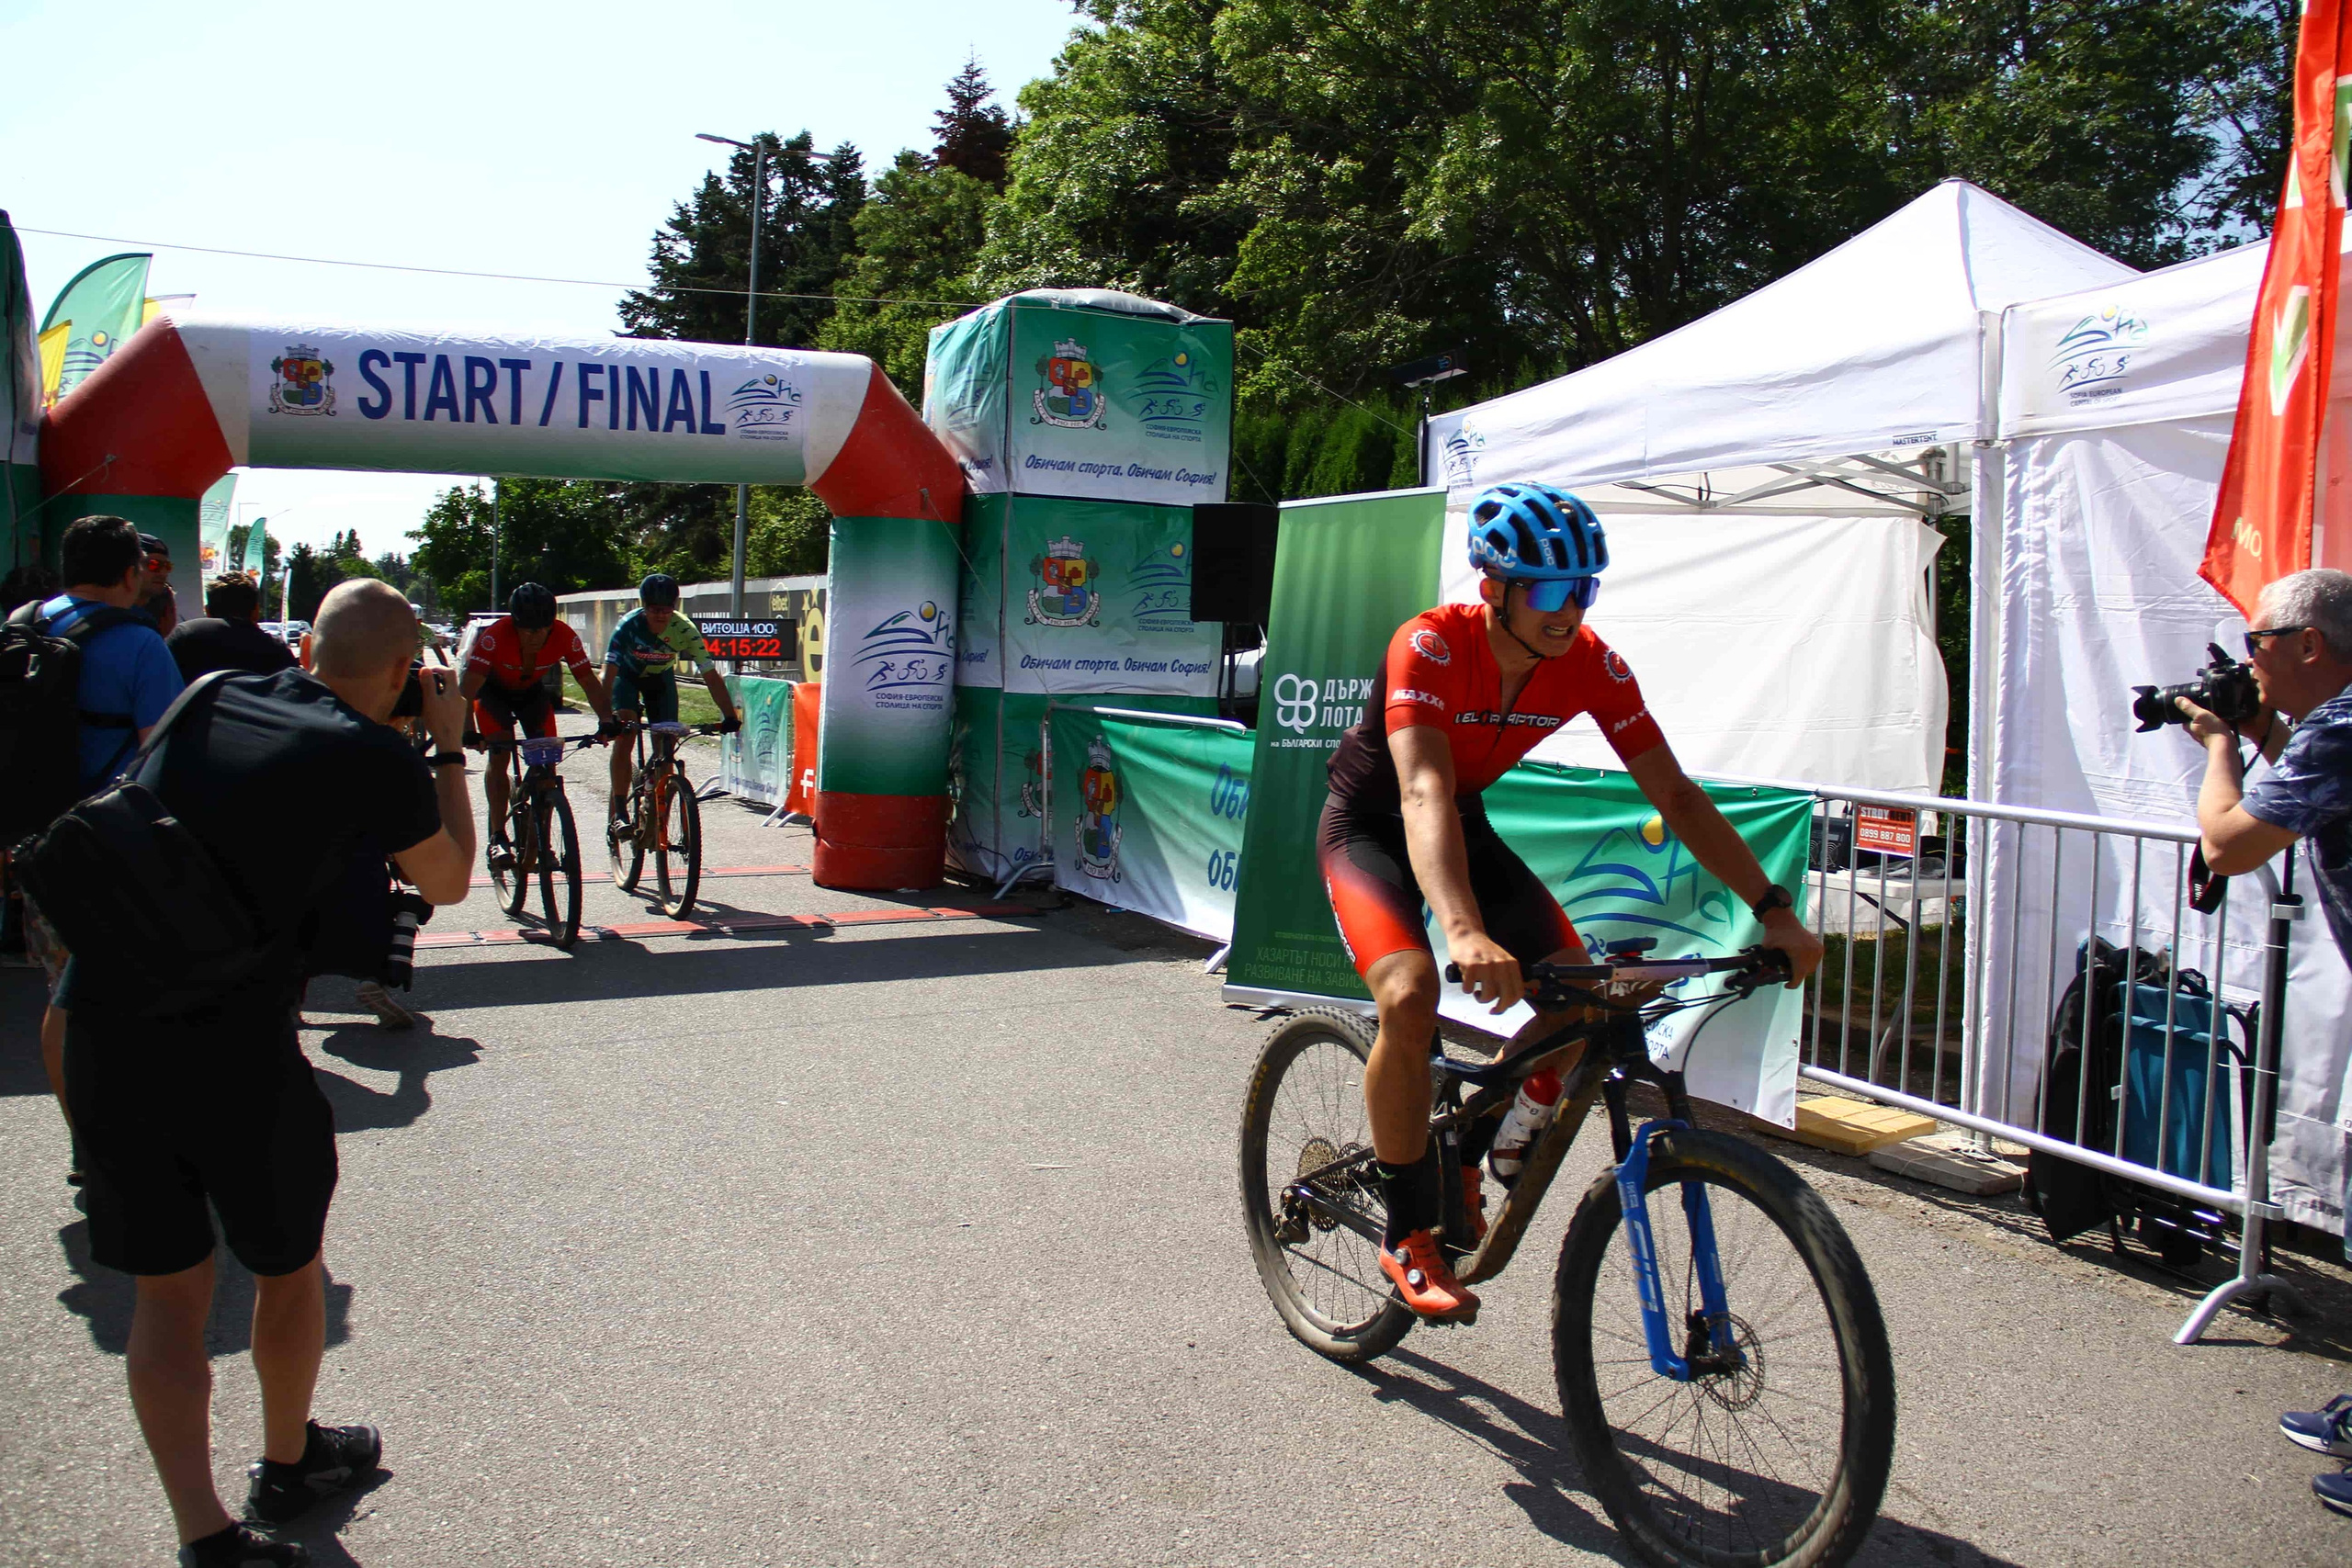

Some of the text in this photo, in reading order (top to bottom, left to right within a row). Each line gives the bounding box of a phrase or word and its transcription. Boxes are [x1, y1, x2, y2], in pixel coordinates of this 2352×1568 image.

[357, 348, 532, 425] START
[578, 363, 726, 436] FINAL
[701, 622, 751, 635] ВИТОША
[876, 701, 910, 709] СТОЛИЦА
[912, 702, 922, 710] НА
[1282, 739, 1323, 748] БЪЛГАРСКИ
[1256, 946, 1308, 964] ХАЗАРТЪТ
[1311, 950, 1341, 968] НОСИ
[1244, 964, 1306, 983] РАЗВИВАНЕ
[1307, 968, 1321, 985] НА
[1645, 1037, 1670, 1060] ОРТА
